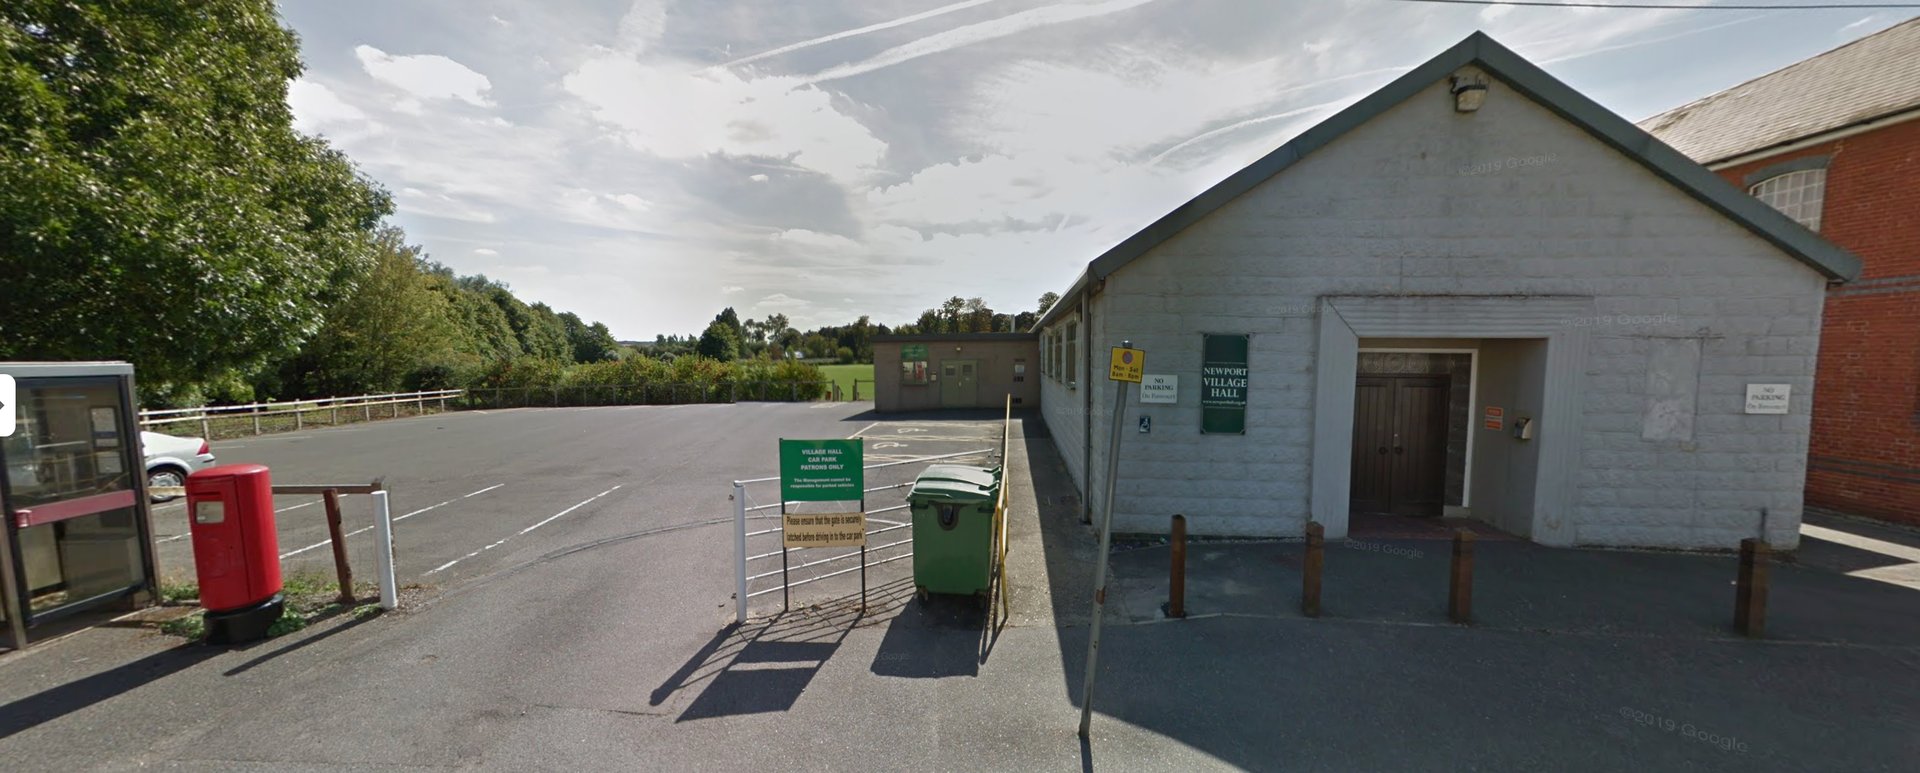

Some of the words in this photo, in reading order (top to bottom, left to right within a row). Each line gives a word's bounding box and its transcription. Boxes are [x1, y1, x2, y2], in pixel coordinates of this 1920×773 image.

[1204, 367, 1248, 376] NEWPORT
[1204, 378, 1247, 387] VILLAGE
[1211, 388, 1239, 398] HALL
[787, 516, 800, 525] Please
[815, 516, 823, 525] that
[831, 517, 840, 527] gate
[845, 515, 861, 525] securely
[787, 532, 801, 541] latched
[802, 532, 815, 541] before
[816, 532, 829, 543] driving
[854, 531, 862, 542] park
